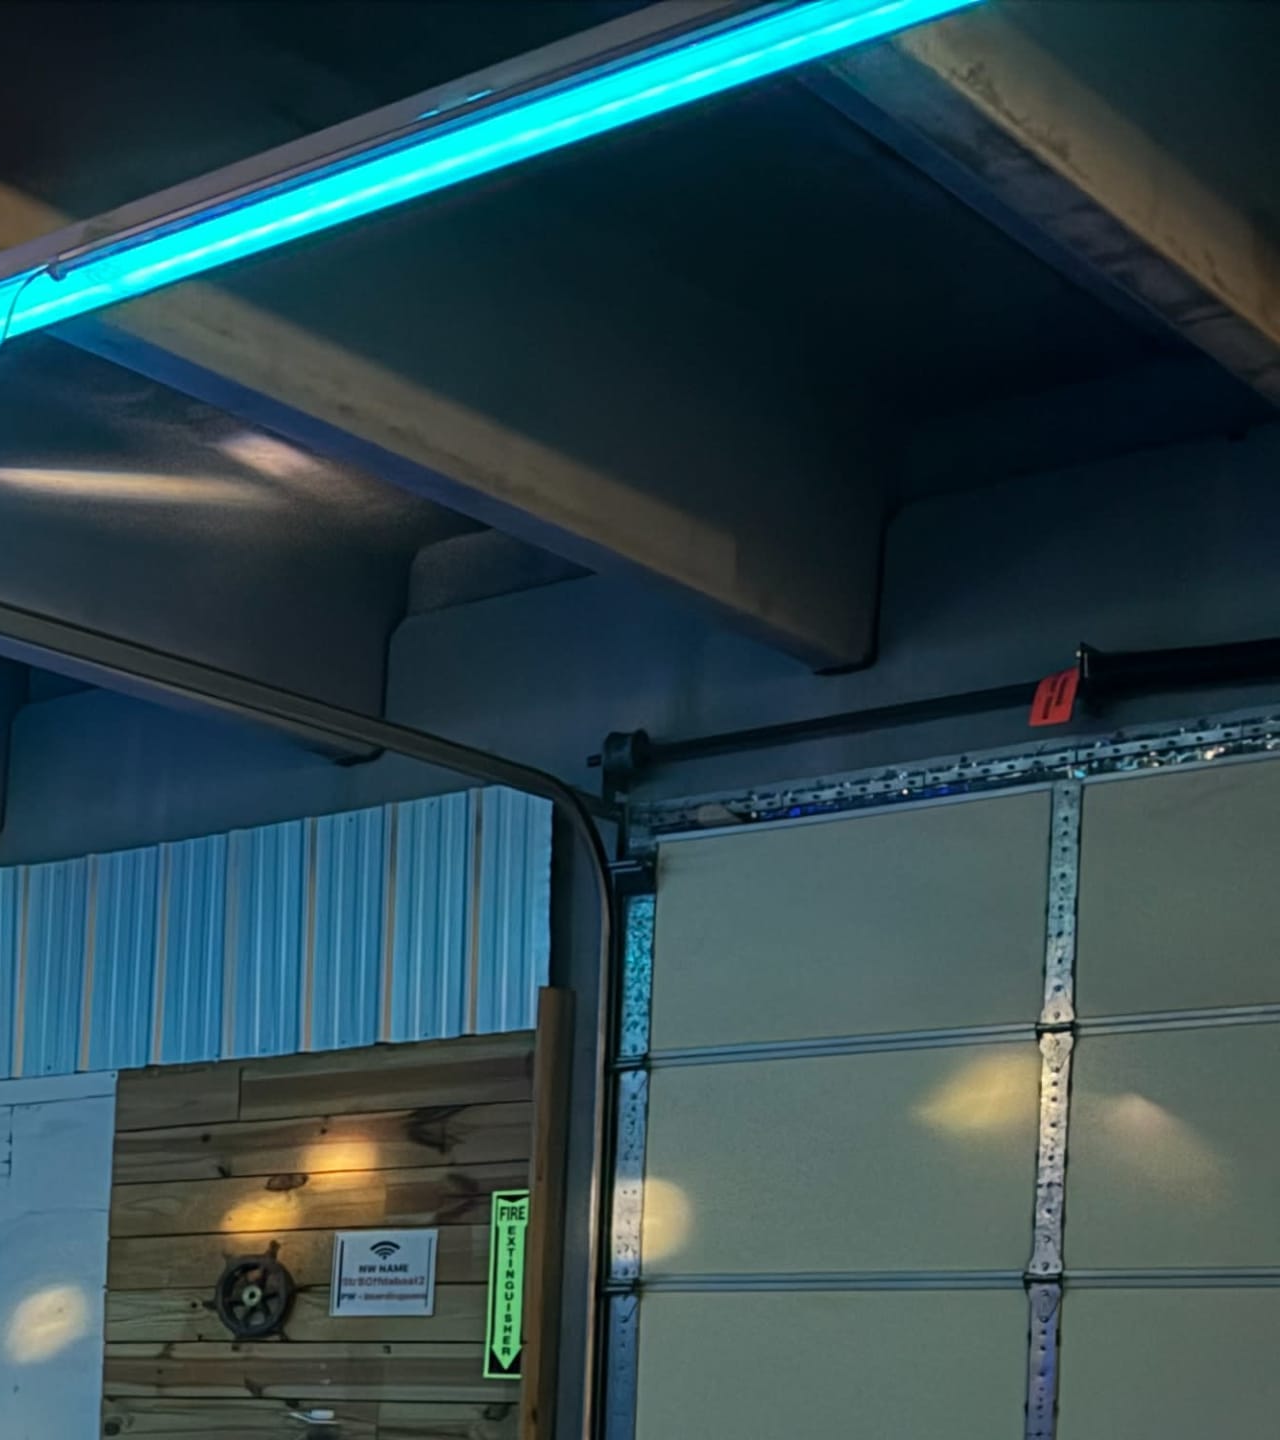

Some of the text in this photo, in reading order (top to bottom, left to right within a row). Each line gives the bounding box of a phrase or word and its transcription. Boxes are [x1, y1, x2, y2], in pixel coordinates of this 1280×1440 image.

[500, 1205, 526, 1221] FIRE
[379, 1264, 408, 1273] NAME
[501, 1225, 517, 1356] EXTINGUISHER
